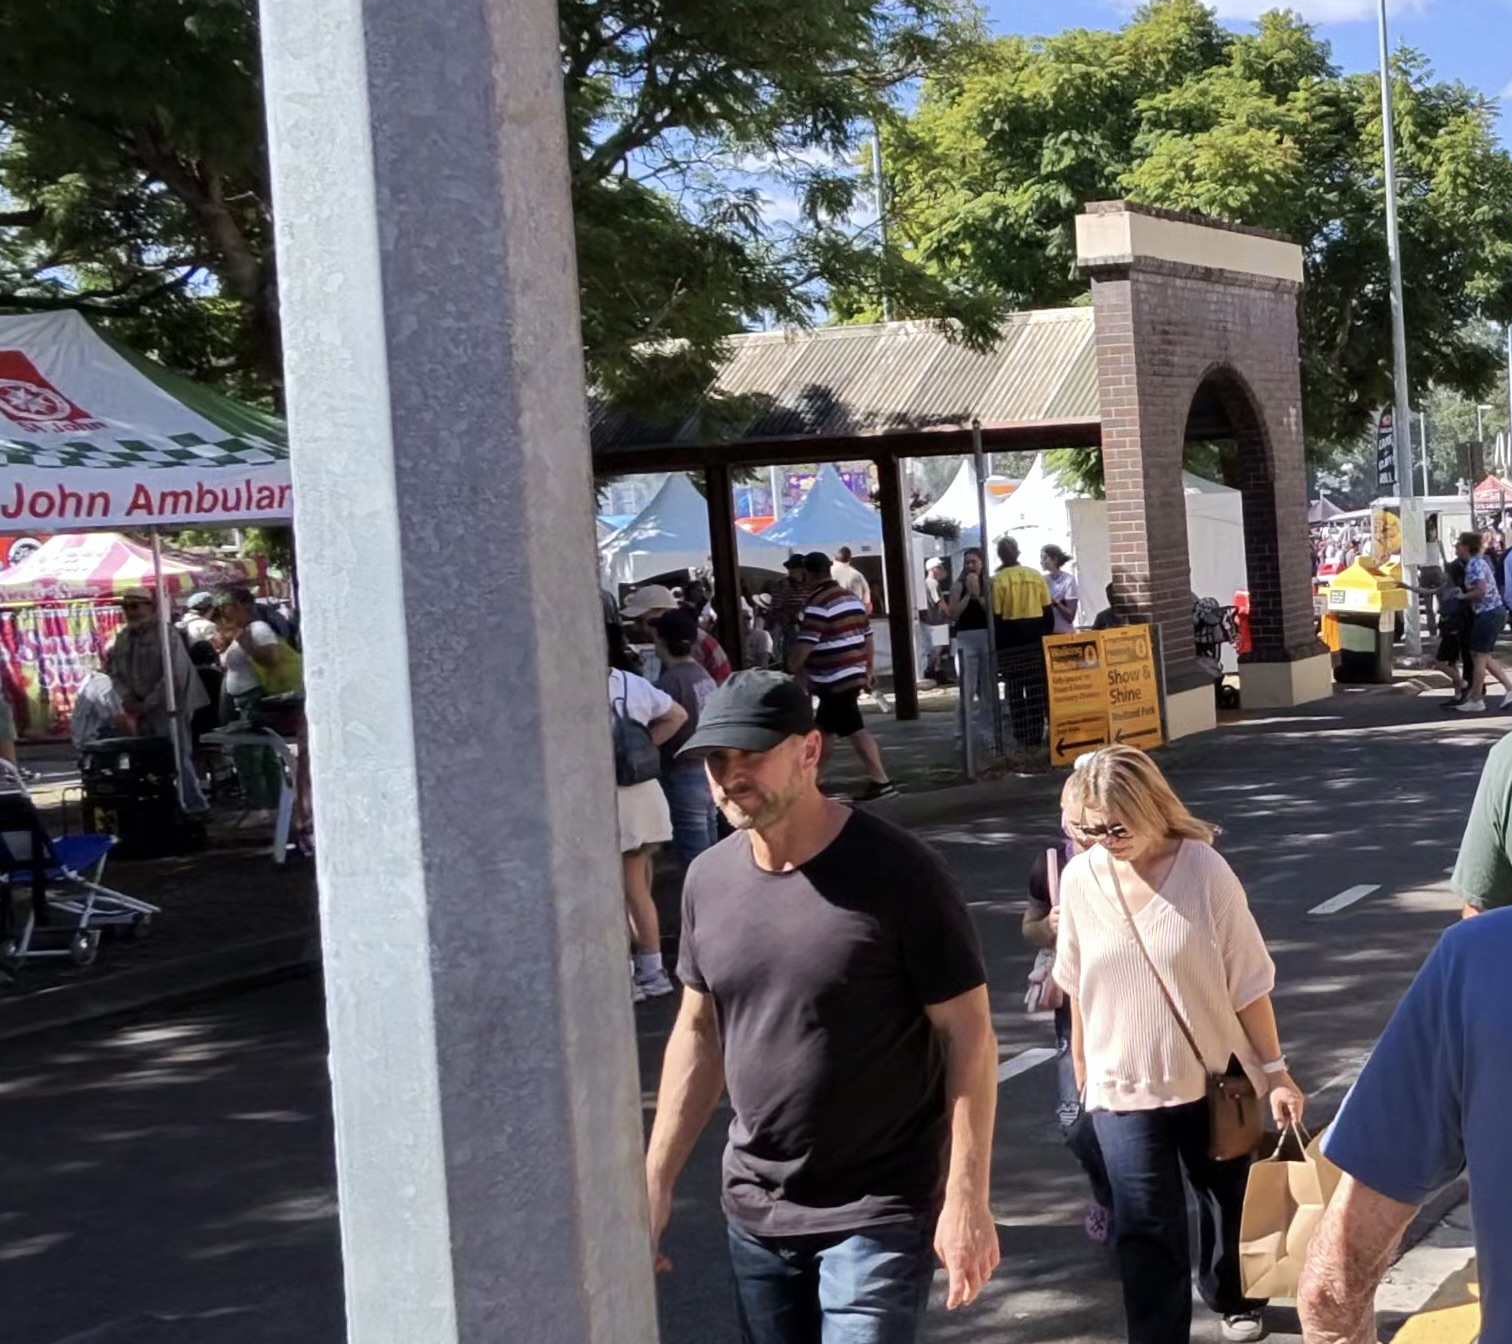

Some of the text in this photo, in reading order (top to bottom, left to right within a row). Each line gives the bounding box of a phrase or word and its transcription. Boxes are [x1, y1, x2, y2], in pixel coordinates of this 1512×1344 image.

[1, 482, 111, 518] John
[1108, 669, 1140, 686] Show
[1143, 665, 1151, 680] &
[1110, 688, 1142, 704] Shine
